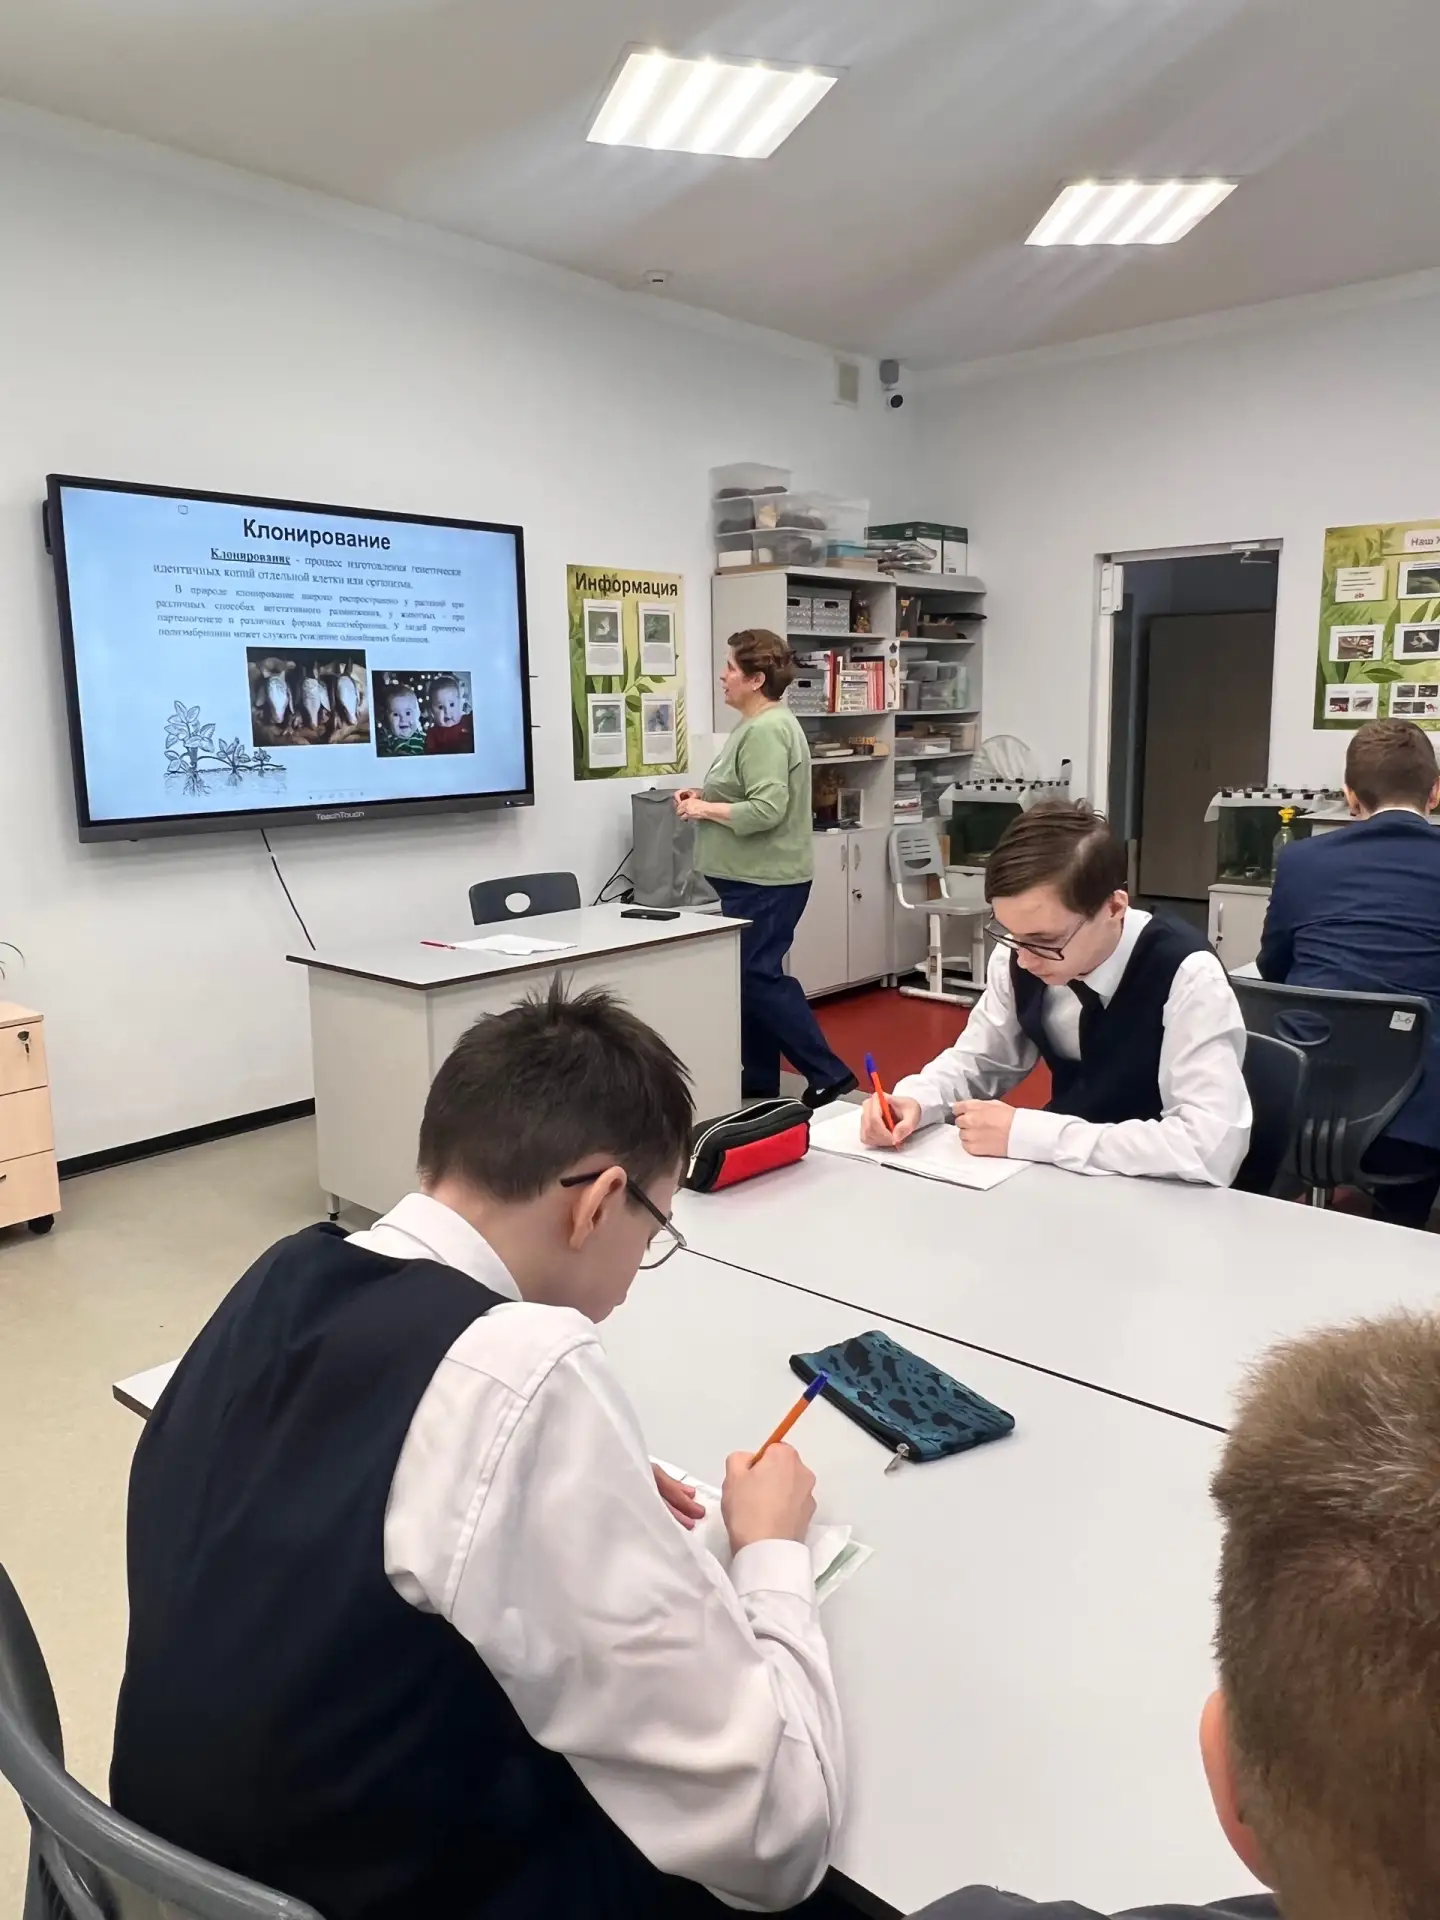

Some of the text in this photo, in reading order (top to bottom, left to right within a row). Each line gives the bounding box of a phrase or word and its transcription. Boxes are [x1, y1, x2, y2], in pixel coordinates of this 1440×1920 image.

[243, 518, 391, 549] Клонирование
[210, 547, 291, 565] Клонирование
[305, 557, 342, 568] процесс
[347, 560, 406, 572] изготовления
[153, 564, 221, 577] идентичных
[224, 568, 255, 579] копий
[258, 570, 310, 582] отдельной
[312, 575, 345, 584] клетки
[346, 577, 364, 586] или
[575, 571, 678, 597] Информация
[175, 584, 182, 593] В
[190, 585, 228, 596] природе
[235, 589, 294, 599] клонирование
[156, 600, 206, 610] различных
[214, 601, 255, 612] способах
[263, 604, 321, 615] вегетативного
